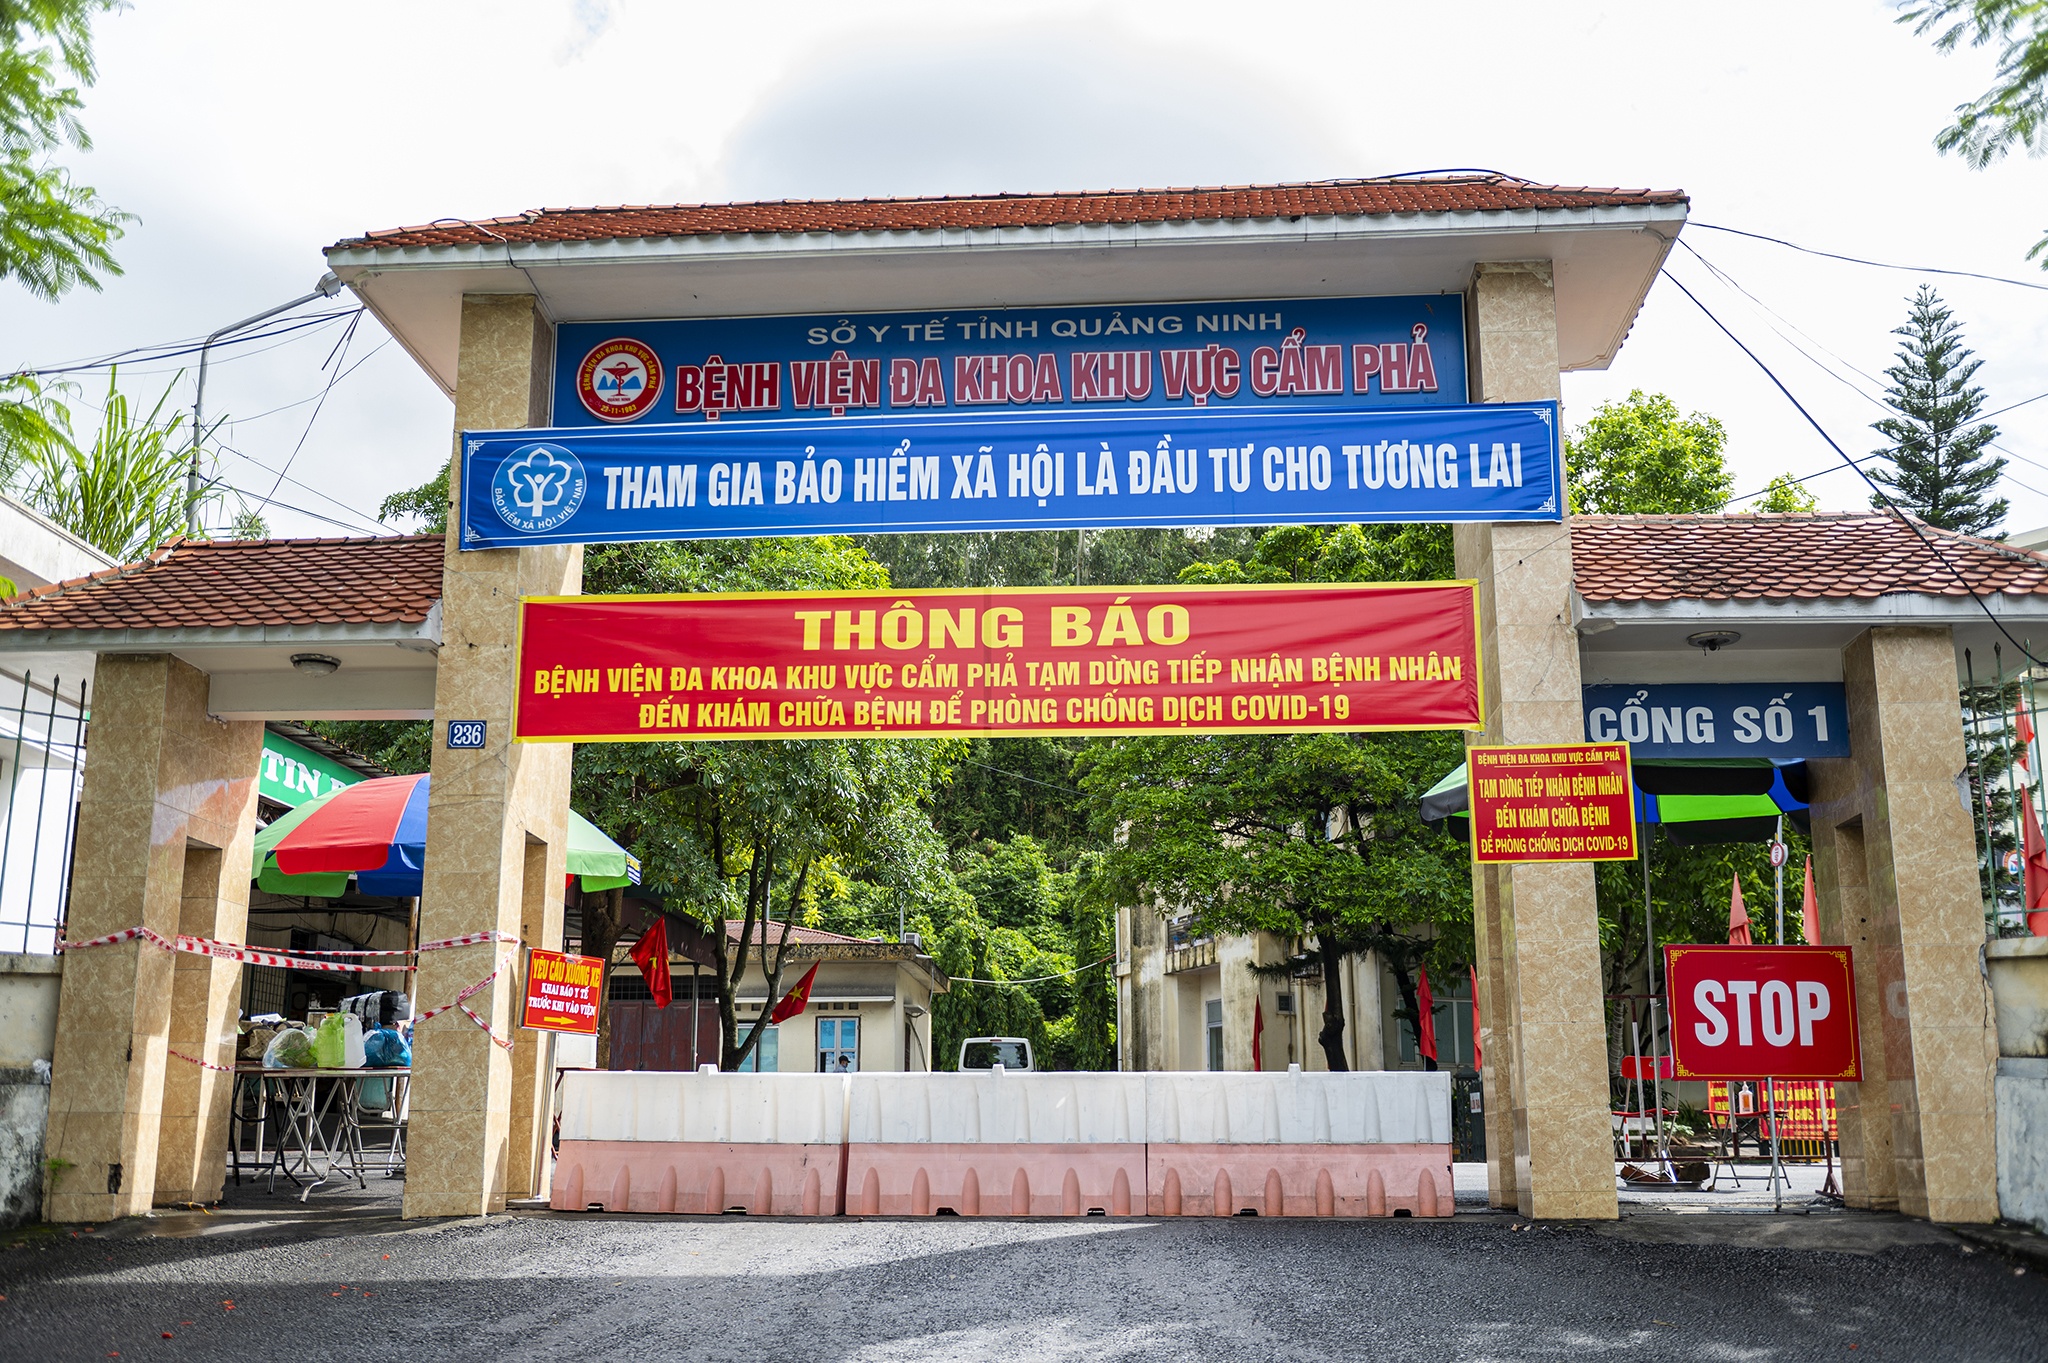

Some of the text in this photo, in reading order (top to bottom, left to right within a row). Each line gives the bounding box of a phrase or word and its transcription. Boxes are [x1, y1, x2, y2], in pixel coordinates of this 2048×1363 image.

[807, 311, 1282, 345] SỞ Y TẾ TỈNH QUẢNG NINH
[675, 322, 1439, 421] BỆNH VIỆN ĐA KHOA KHU VỰC CẨM PHẢ
[603, 434, 1523, 510] THAM GIA BẢO HIỂM XÃ HỘI LÀ ĐẦU TƯ CHO TƯƠNG LAI
[495, 478, 583, 529] BẢO HIỂM XÃ HỘI VIỆT NAM
[794, 596, 1190, 651] THÔNG BÁO
[534, 650, 1462, 699] BỆNH VIỆN ĐA KHOA KHU VỰC CẨM PHẢ TẠM DỪNG TIẾP NHẬN BỆNH NHÂN
[639, 689, 1350, 730] ĐẾN KHÁM CHỮA BỆNH ĐỂ PHÒNG CHỐNG DỊCH COVID-19
[1589, 690, 1829, 744] CỔNG SỐ 1
[453, 725, 482, 745] 236
[1478, 748, 1620, 767] BỆNH VIỆN ĐA KHOA KHU VỰC CẨM PHẢ
[1479, 771, 1624, 802] TẠM DỪNG TIẾP NHẬN BỆNH NHÂN
[1496, 802, 1610, 830] ĐẾN KHÁM CHỮA BỆNH
[1481, 830, 1629, 856] ĐỂ PHÒNG CHỐNG DỊCH COVID-19
[533, 956, 549, 980] YÊU
[565, 960, 590, 986] XUỐNG
[590, 967, 601, 988] XE
[541, 982, 590, 1000] KHAI BÁO Y TẾ
[1693, 979, 1831, 1047] STOP
